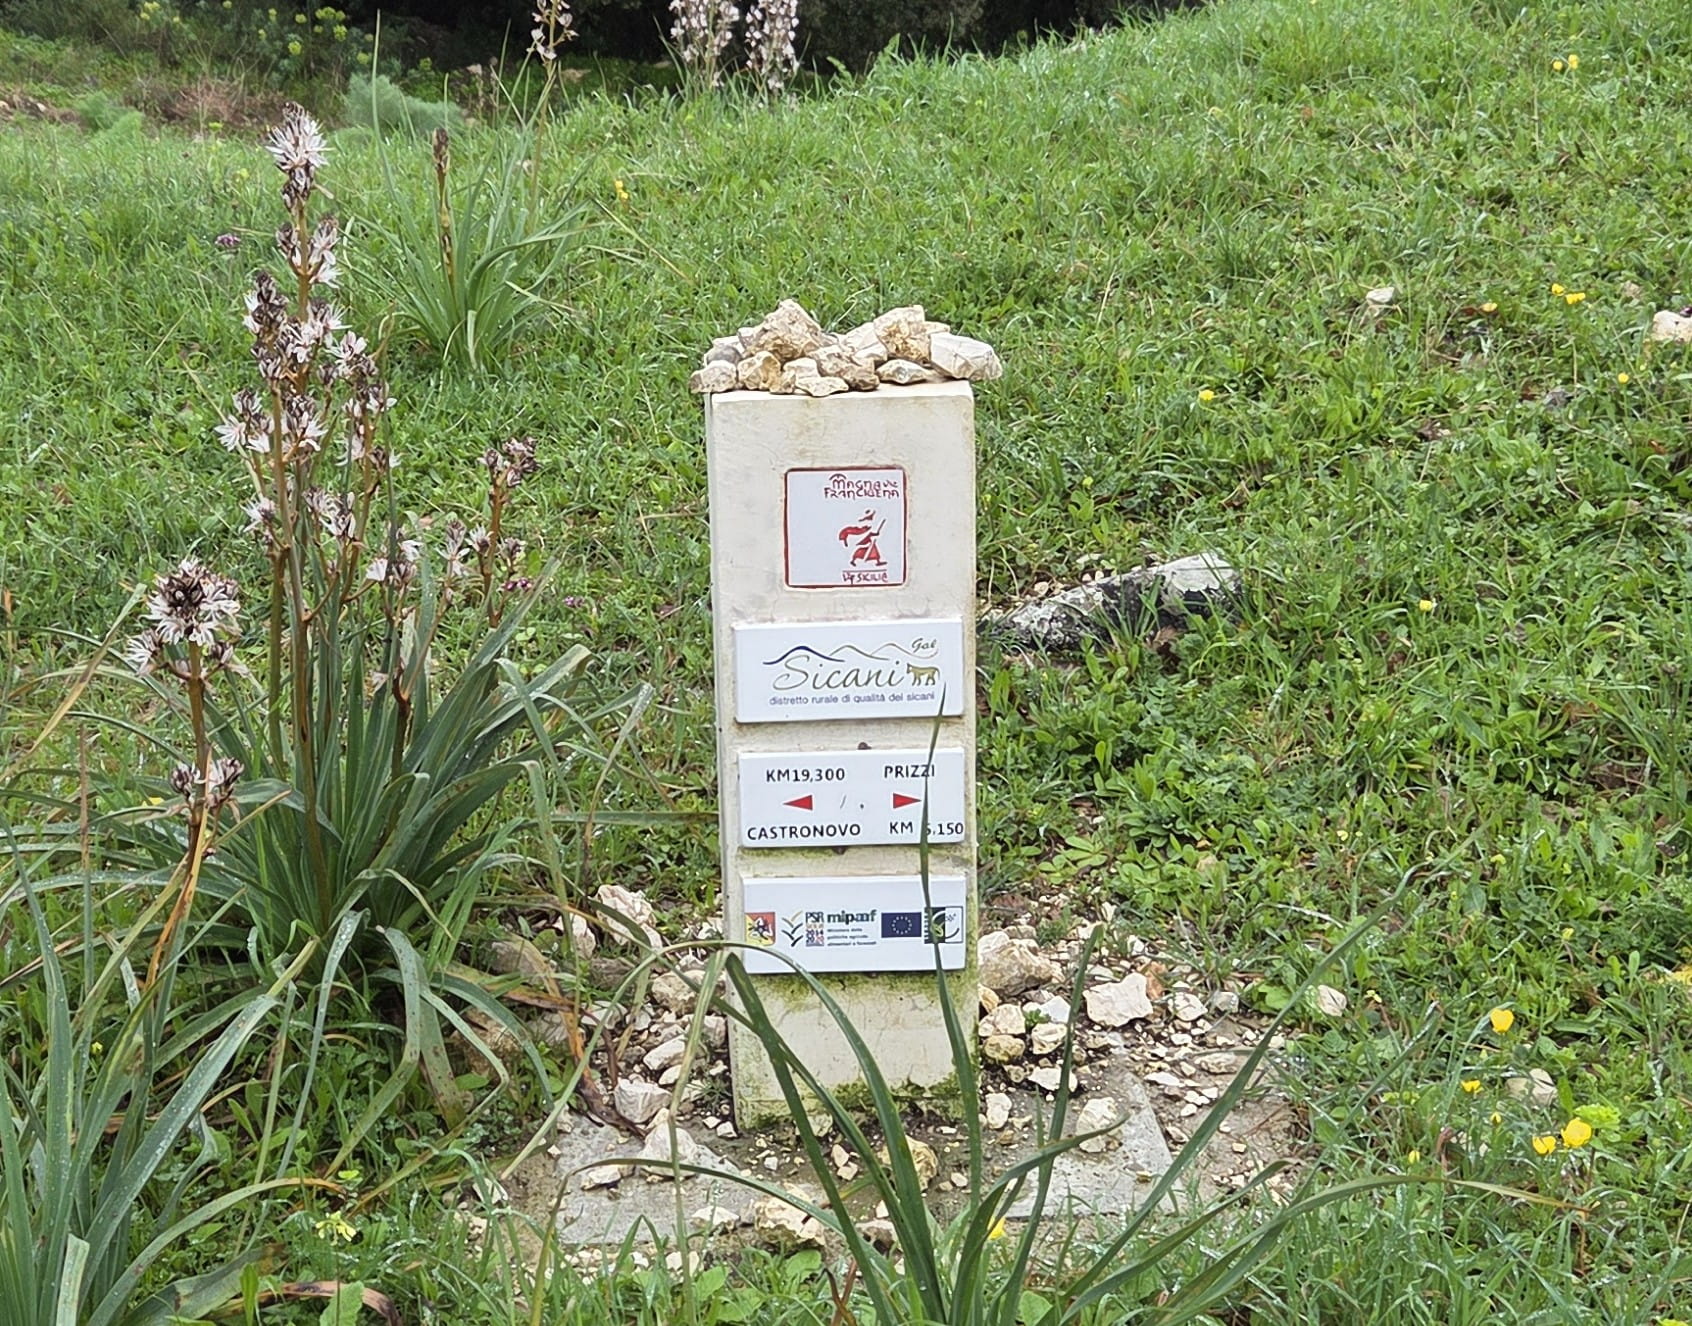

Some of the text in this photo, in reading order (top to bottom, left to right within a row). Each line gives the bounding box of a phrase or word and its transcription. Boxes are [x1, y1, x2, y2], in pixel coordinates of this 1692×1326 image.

[911, 637, 938, 653] Gal
[772, 655, 904, 690] Sicani
[769, 691, 935, 706] distretto rurale di qualità dei sicani
[766, 768, 845, 783] KM19,300
[884, 764, 935, 778] PRIZZI
[747, 823, 861, 840] CASTRONOVO
[889, 821, 914, 834] KM
